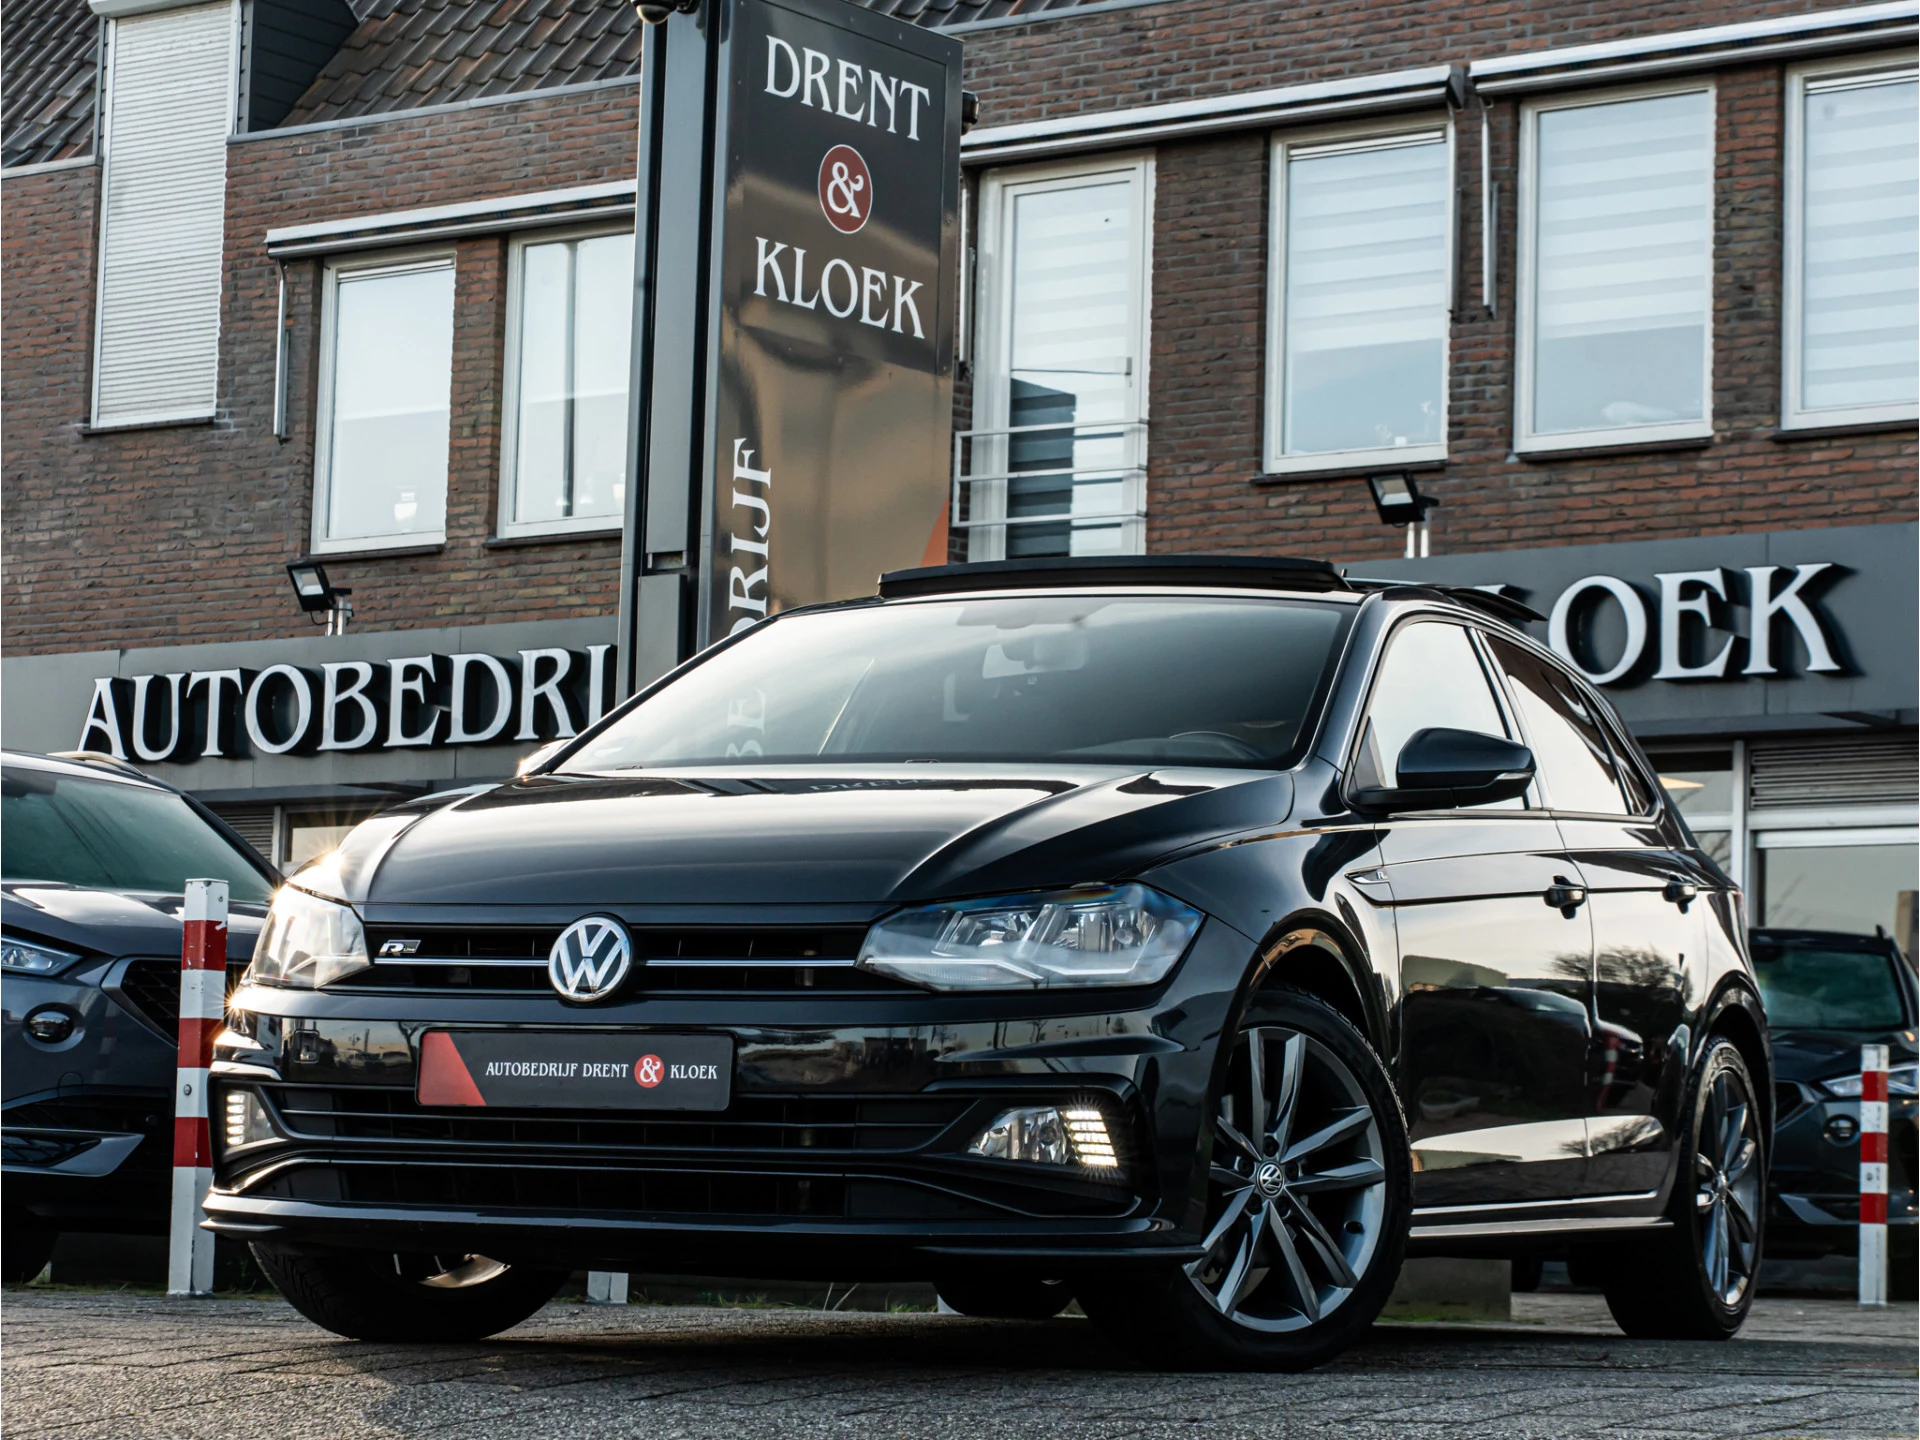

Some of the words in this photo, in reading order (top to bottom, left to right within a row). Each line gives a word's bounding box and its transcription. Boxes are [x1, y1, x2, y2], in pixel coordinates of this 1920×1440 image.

[764, 35, 930, 141] DRENT
[826, 161, 864, 218] &
[753, 236, 925, 339] KLOEK
[1474, 562, 1842, 685] OEK
[77, 644, 612, 762] AUTOBEDRI
[485, 1062, 578, 1078] AUTOBEDRIJF
[582, 1063, 629, 1078] DRENT
[639, 1057, 661, 1083] &
[670, 1064, 717, 1079] KLOEK
